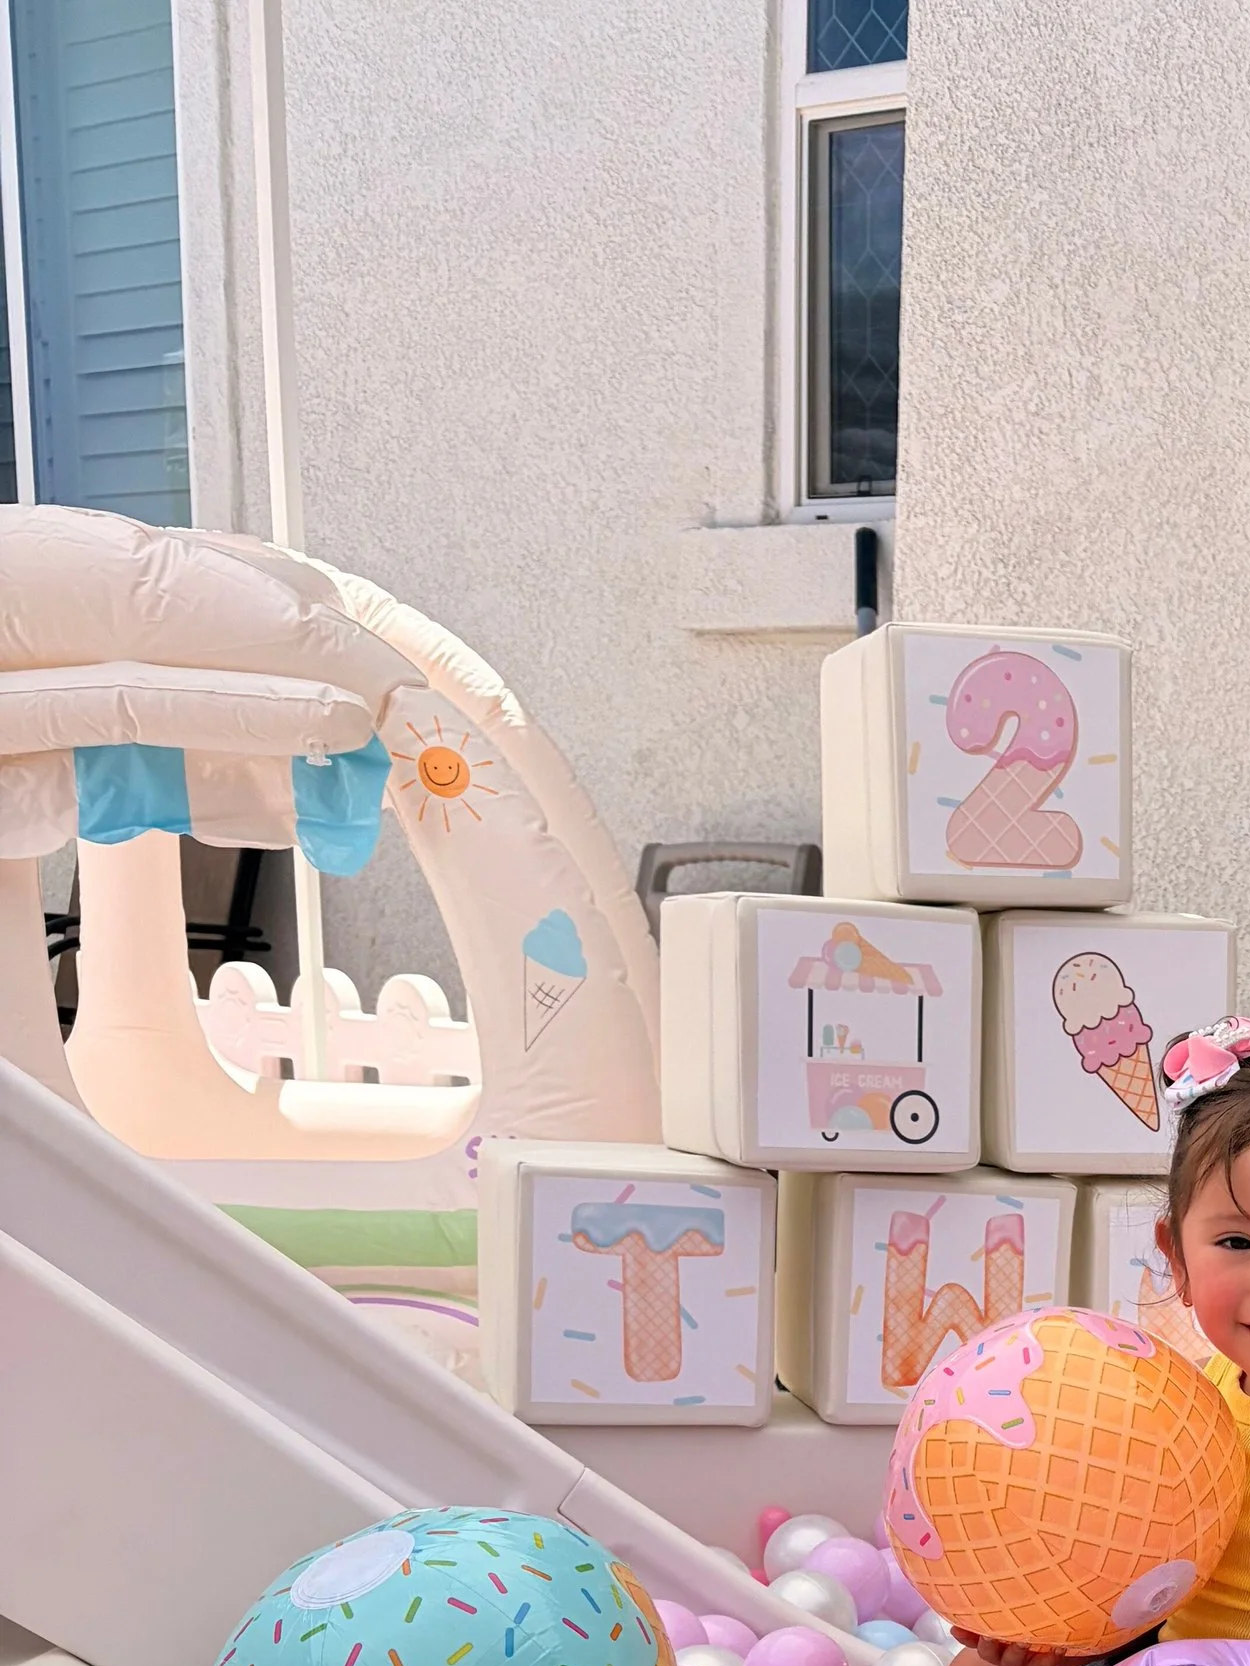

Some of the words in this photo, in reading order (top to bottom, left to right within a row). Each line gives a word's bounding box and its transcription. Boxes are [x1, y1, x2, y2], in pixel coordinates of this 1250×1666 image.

[946, 651, 1083, 869] 2
[830, 1073, 850, 1088] ICE
[858, 1074, 903, 1090] CREAM
